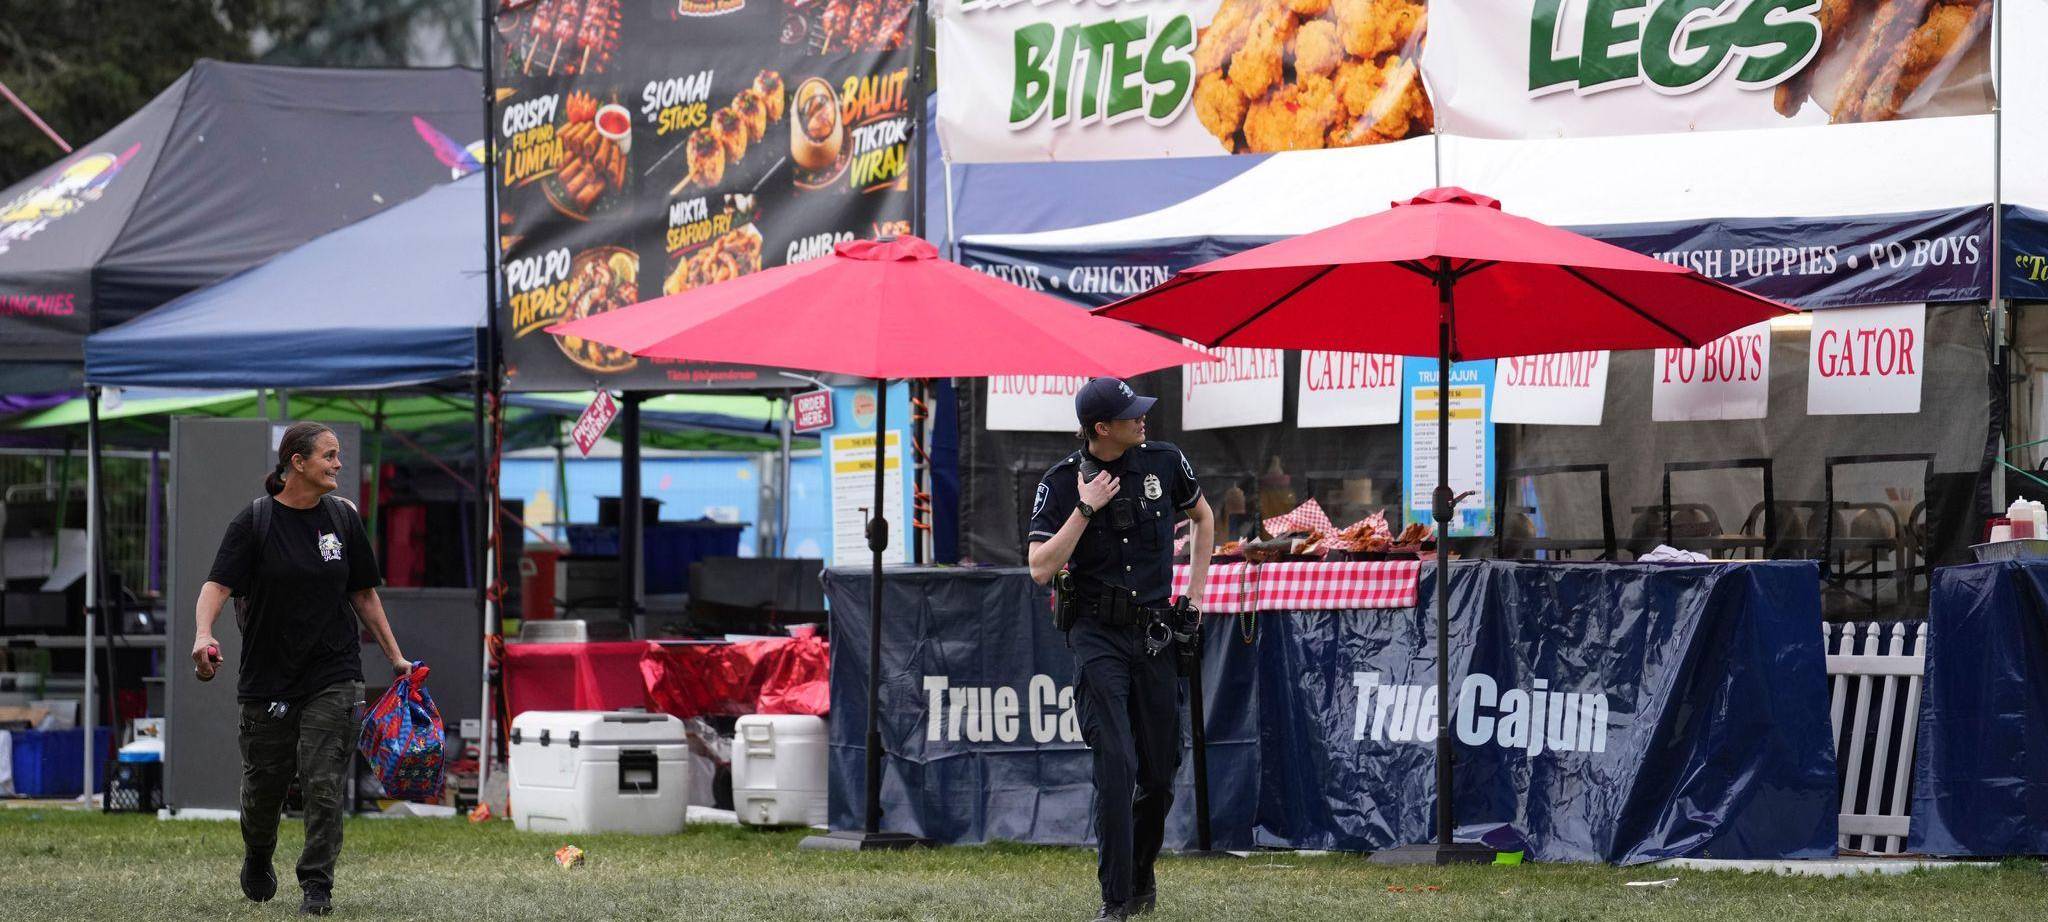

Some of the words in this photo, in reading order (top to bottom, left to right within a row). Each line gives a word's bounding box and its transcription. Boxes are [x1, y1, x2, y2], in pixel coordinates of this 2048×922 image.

[1528, 0, 1818, 92] LEGS
[1009, 14, 1193, 124] BITES
[641, 70, 714, 115] SIOMAI
[502, 94, 559, 138] CRISPY
[657, 102, 707, 136] STICKS
[852, 118, 907, 156] TIKTOK
[504, 137, 563, 187] LUMPIA
[851, 144, 907, 189] VIRAL
[666, 219, 712, 253] SEAFOOD
[713, 214, 732, 236] FRY
[669, 197, 708, 228] MIXTA
[507, 247, 571, 297] POLPO
[1729, 244, 1839, 279] PUPPIES
[1870, 243, 1907, 270] PO
[1912, 235, 1981, 267] BOYS
[1067, 265, 1170, 294] CHICKEN
[510, 281, 568, 330] TAPAS
[1306, 350, 1396, 392] CATFISH
[1506, 350, 1599, 388] SHRIMP
[1662, 348, 1697, 384] PO
[1702, 334, 1763, 382] BOYS
[1817, 327, 1916, 378] GATOR
[574, 391, 607, 443] PICK-UP
[798, 394, 826, 413] ORDER
[802, 410, 824, 426] HERE
[587, 413, 608, 443] HERE
[922, 675, 1020, 743] True
[1353, 671, 1438, 743] True
[1456, 673, 1609, 757] Cajun
